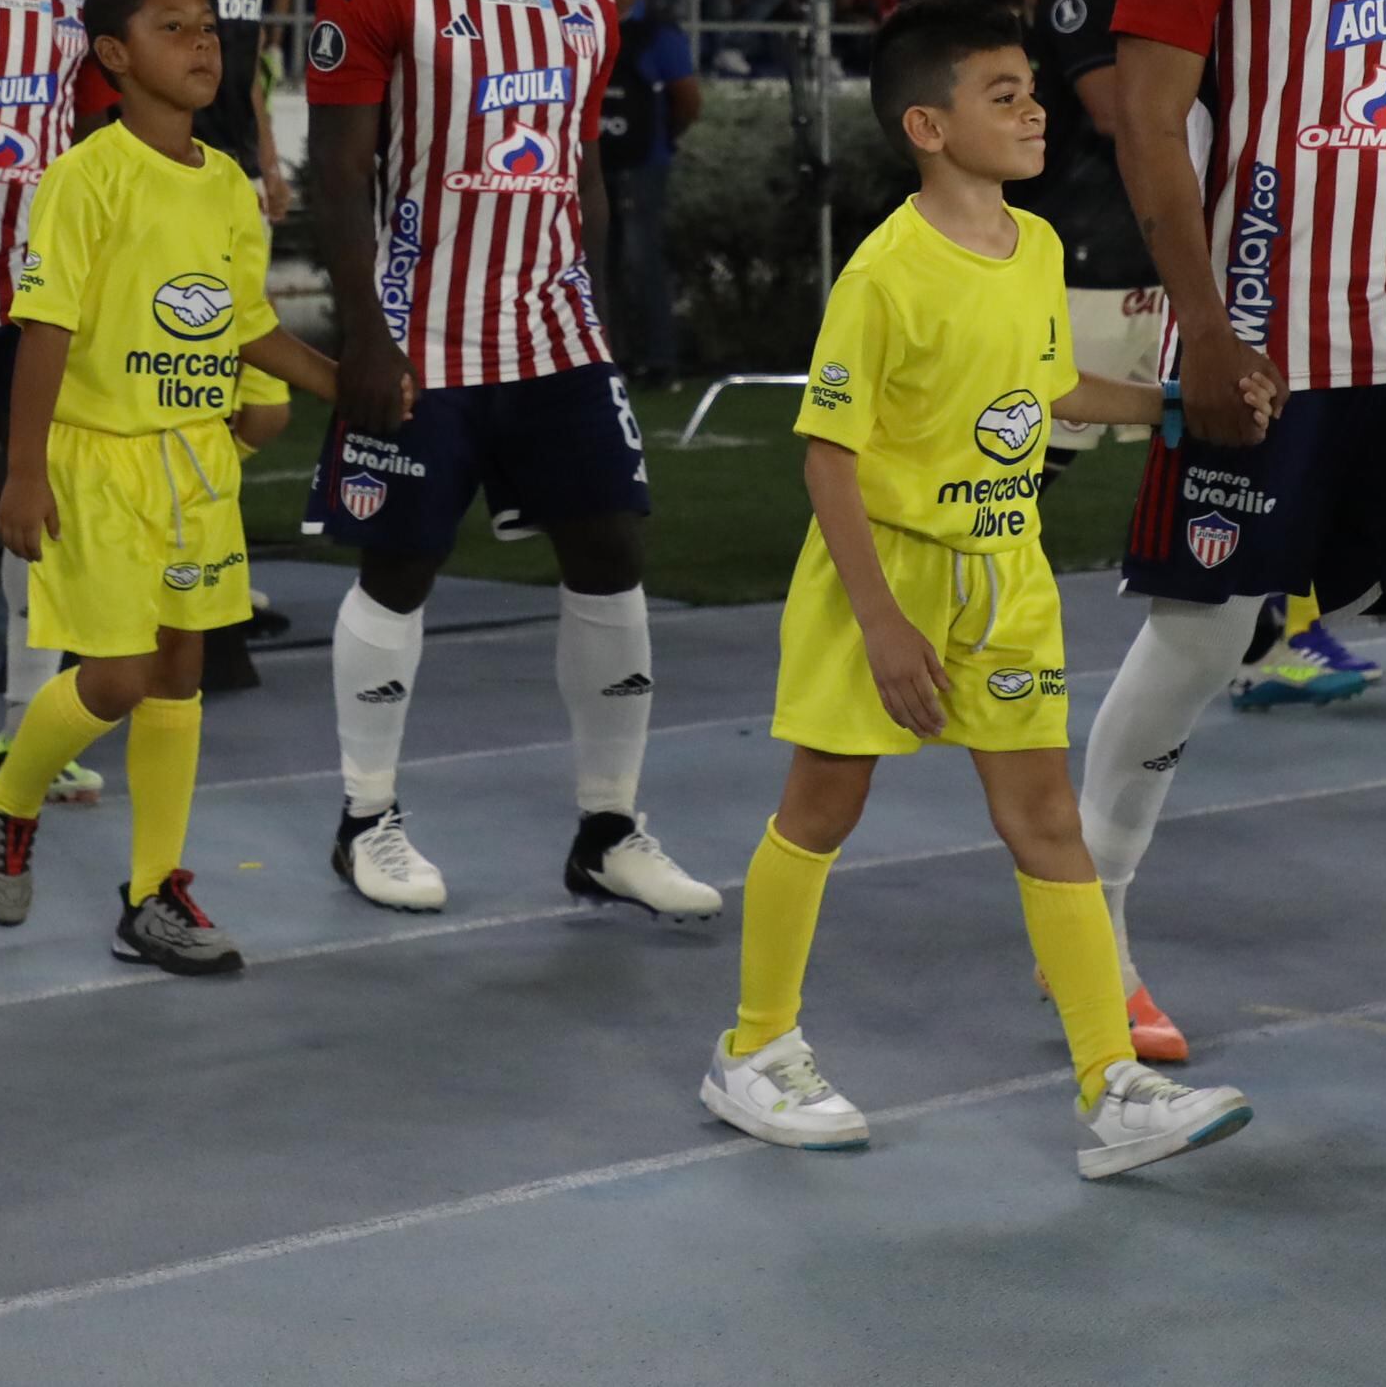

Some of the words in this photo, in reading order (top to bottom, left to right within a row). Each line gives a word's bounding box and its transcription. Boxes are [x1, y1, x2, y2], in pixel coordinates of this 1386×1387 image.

[480, 68, 565, 112] AGUILA
[157, 378, 224, 409] libre
[342, 443, 426, 478] brasilia
[1187, 464, 1250, 489] expreso
[970, 506, 1025, 538] libre
